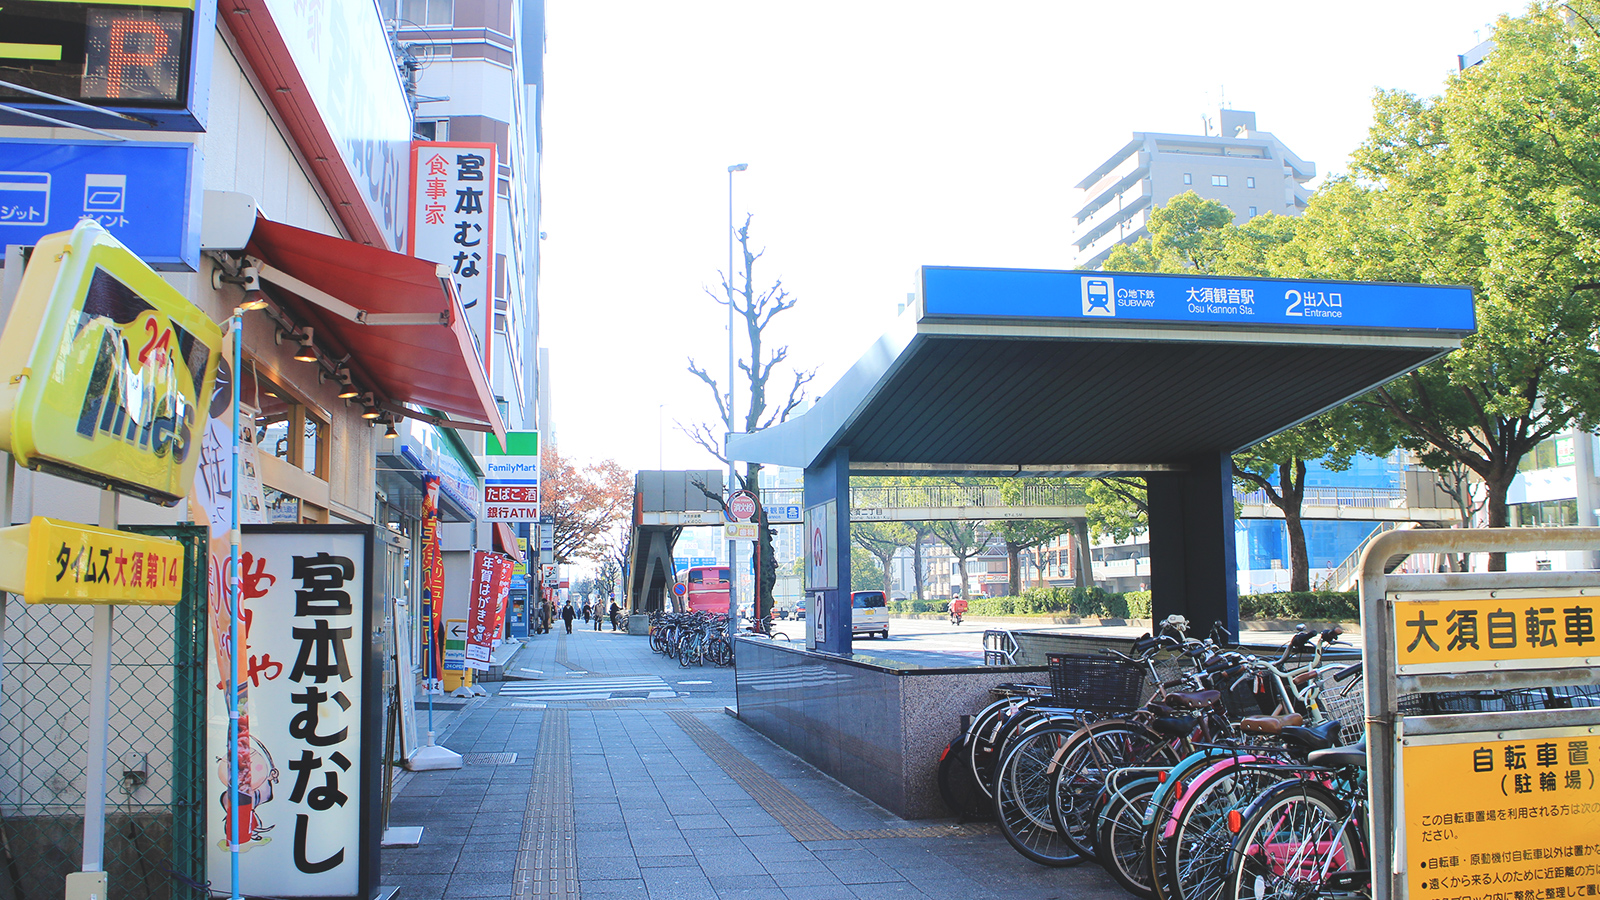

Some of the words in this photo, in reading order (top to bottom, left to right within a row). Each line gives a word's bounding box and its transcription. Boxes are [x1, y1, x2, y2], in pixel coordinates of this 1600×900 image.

[106, 20, 169, 98] P
[425, 154, 450, 225] 食事家
[1128, 289, 1155, 299] 地下鉄
[1186, 287, 1255, 304] 大須観音駅
[1304, 291, 1342, 307] 出入口
[1117, 299, 1155, 307] SUBWAY
[1188, 303, 1205, 313] Osu
[1207, 304, 1238, 314] Kannon
[1239, 305, 1255, 314] Sta.
[1304, 308, 1342, 317] Entrance
[488, 464, 536, 473] FamilyMart
[487, 488, 536, 501] たばこ・酒
[487, 507, 537, 518] 銀行ATM
[477, 556, 494, 622] 年賀はがき
[1406, 605, 1596, 651] 大須自転車
[289, 552, 355, 874] 宮本むなし
[1473, 741, 1600, 773] 自転車置
[1422, 802, 1600, 827] この自転車置場を利用される方は次の
[1422, 829, 1459, 843] ださい。
